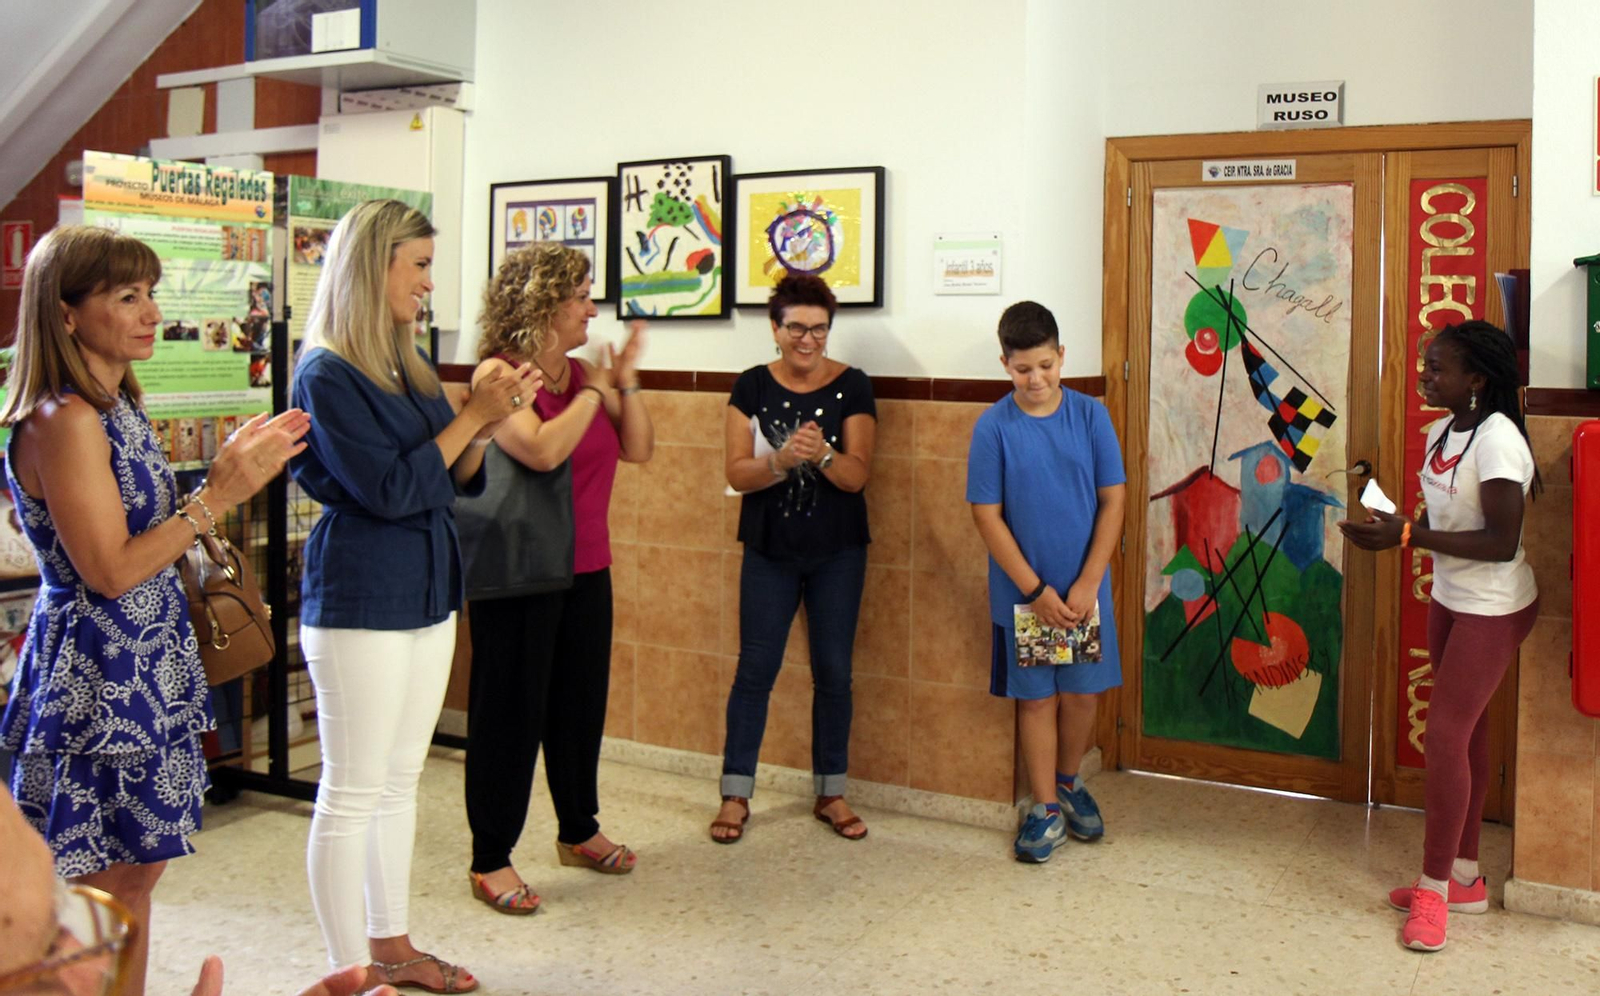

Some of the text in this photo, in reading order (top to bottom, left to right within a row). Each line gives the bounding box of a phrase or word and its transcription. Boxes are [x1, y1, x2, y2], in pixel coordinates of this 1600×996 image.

[1266, 91, 1337, 104] MUSEO
[1273, 110, 1329, 121] RUSO
[1266, 166, 1272, 176] de
[1273, 164, 1292, 176] GRACIA
[105, 161, 267, 205] PROYECTO Puertas Regaladas
[1243, 247, 1343, 323] Chagall
